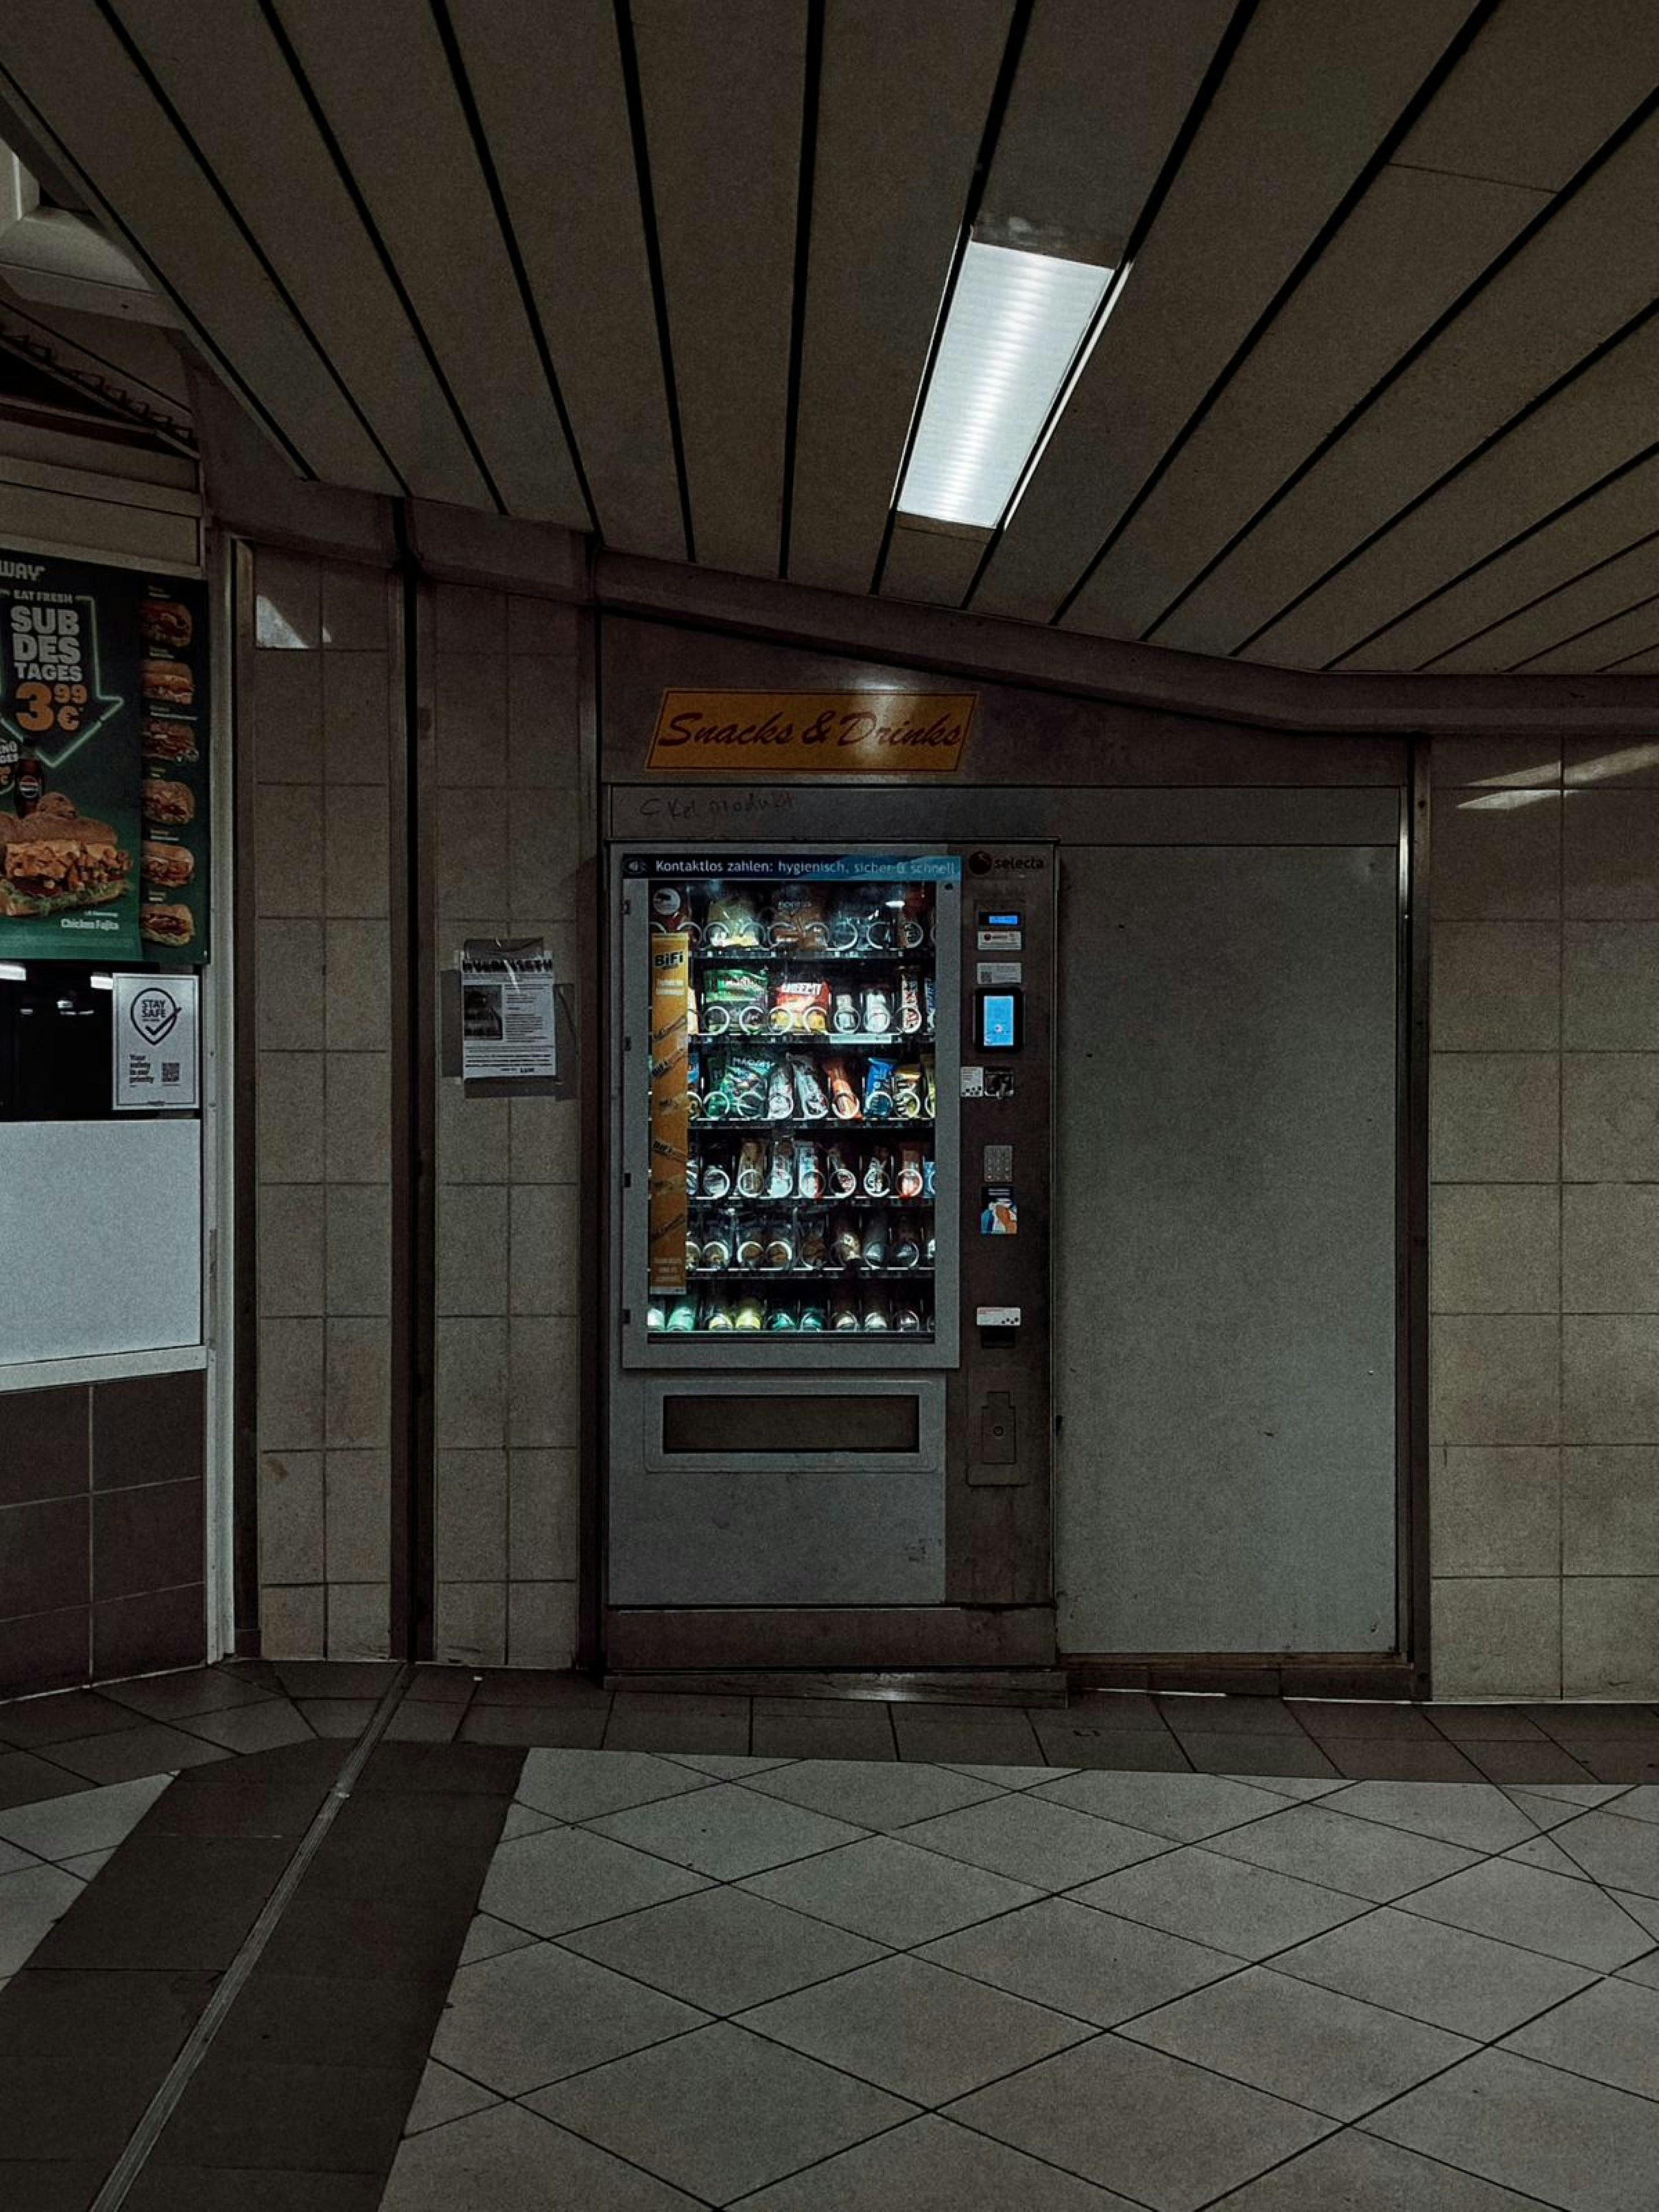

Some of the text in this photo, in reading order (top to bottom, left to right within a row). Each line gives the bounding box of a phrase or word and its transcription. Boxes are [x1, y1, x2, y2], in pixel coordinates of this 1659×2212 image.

[13, 589, 34, 601] EAT
[10, 605, 80, 636] SUB
[13, 633, 81, 665] DES
[13, 662, 83, 682] TAGES
[658, 709, 962, 746] Snacks & Drinks
[655, 859, 723, 873] Kontaktlos
[726, 859, 773, 873] zahlen:
[994, 857, 1044, 870] selecta
[655, 951, 683, 967] BiFi
[141, 999, 166, 1008] STAY
[141, 1008, 166, 1018] SAFE
